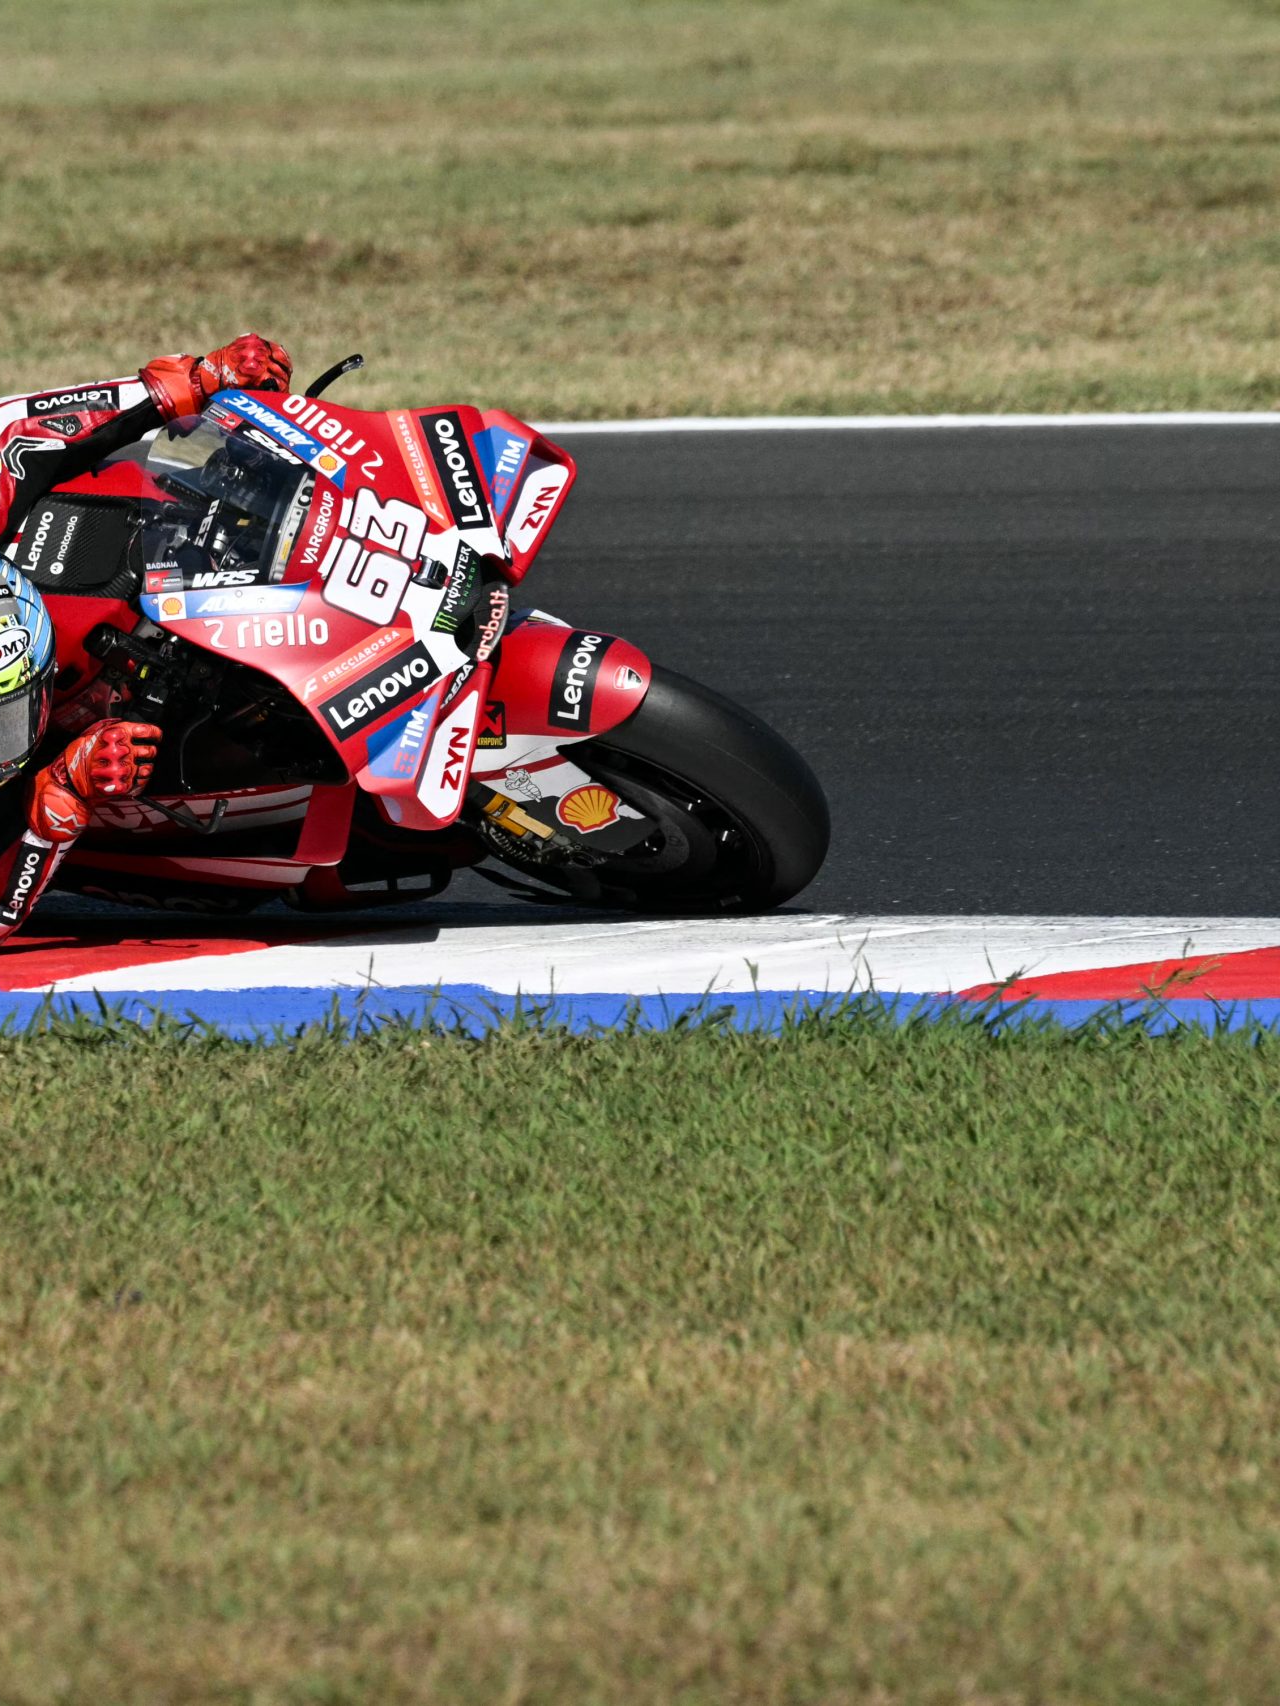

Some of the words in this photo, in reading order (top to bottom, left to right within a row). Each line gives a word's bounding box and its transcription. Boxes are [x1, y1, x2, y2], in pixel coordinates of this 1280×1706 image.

[34, 389, 112, 410] Lenovo
[228, 395, 315, 446] ADVANCE
[282, 394, 366, 456] riello
[242, 429, 303, 465] WRS
[396, 415, 432, 496] FRECCIAROSSA
[435, 418, 484, 524] Lenovo
[496, 439, 525, 474] TIM
[300, 491, 335, 564] VARGROUP
[520, 485, 560, 531] ZYN
[21, 511, 54, 571] Lenovo
[56, 515, 79, 561] motorola
[146, 561, 179, 570] BAGNAIA
[324, 487, 429, 626] 63
[192, 569, 260, 588] WRS
[443, 545, 472, 613] MONSTER
[460, 560, 478, 606] ENERGY
[236, 614, 329, 648] riello
[476, 589, 509, 662] aruba.it
[322, 630, 401, 683] FRECCIAROSSA
[557, 635, 602, 720] Lenovo
[328, 658, 429, 730] Lenovo
[400, 709, 429, 749] TIM
[440, 726, 470, 791] ZYN
[2, 852, 40, 920] Lenovo
